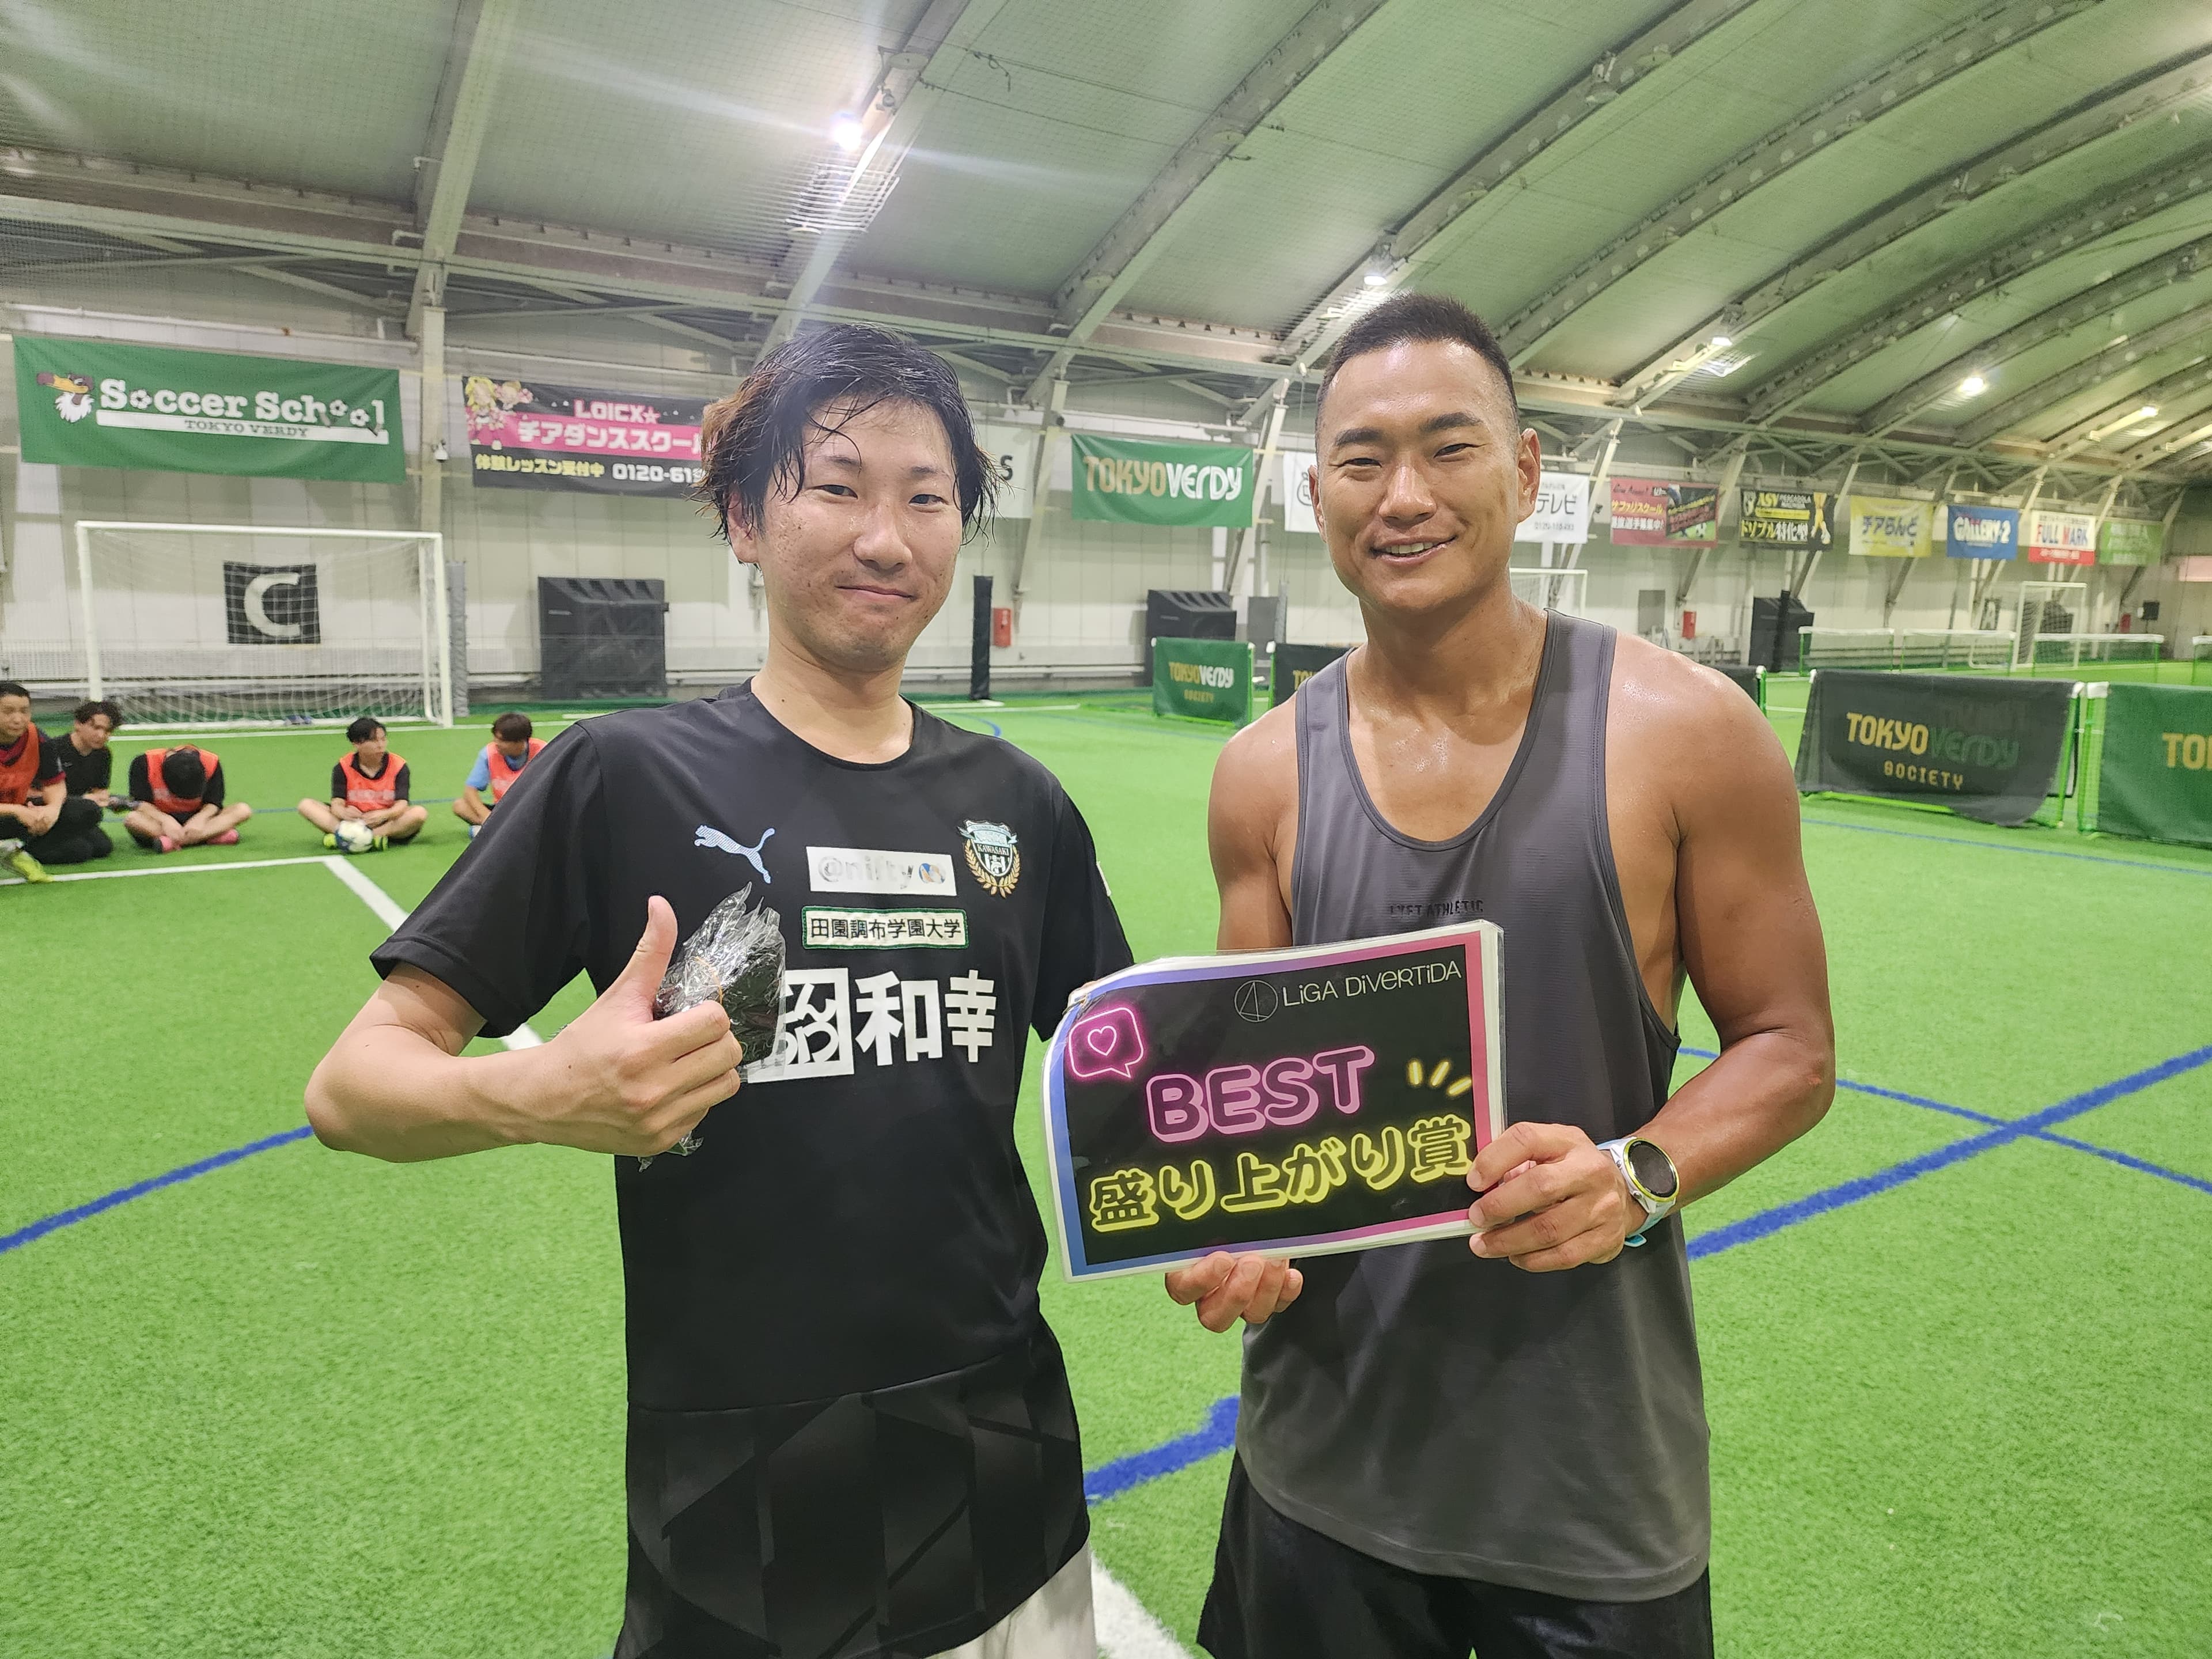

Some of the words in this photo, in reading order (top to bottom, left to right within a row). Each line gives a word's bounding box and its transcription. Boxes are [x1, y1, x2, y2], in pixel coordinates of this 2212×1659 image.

[100, 378, 248, 418] Soccer
[255, 391, 384, 431] School
[185, 420, 244, 434] TOKYO
[249, 423, 308, 437] VERDY
[243, 572, 300, 638] C
[1846, 711, 1929, 756] TOKYO
[1884, 760, 1964, 790] SOCIETY
[977, 843, 1010, 857] KAWASAKI
[810, 918, 961, 940] 田園調布学園大学
[1145, 1045, 1376, 1143] BEST
[1089, 1115, 1472, 1233] 盛り上がり賞
